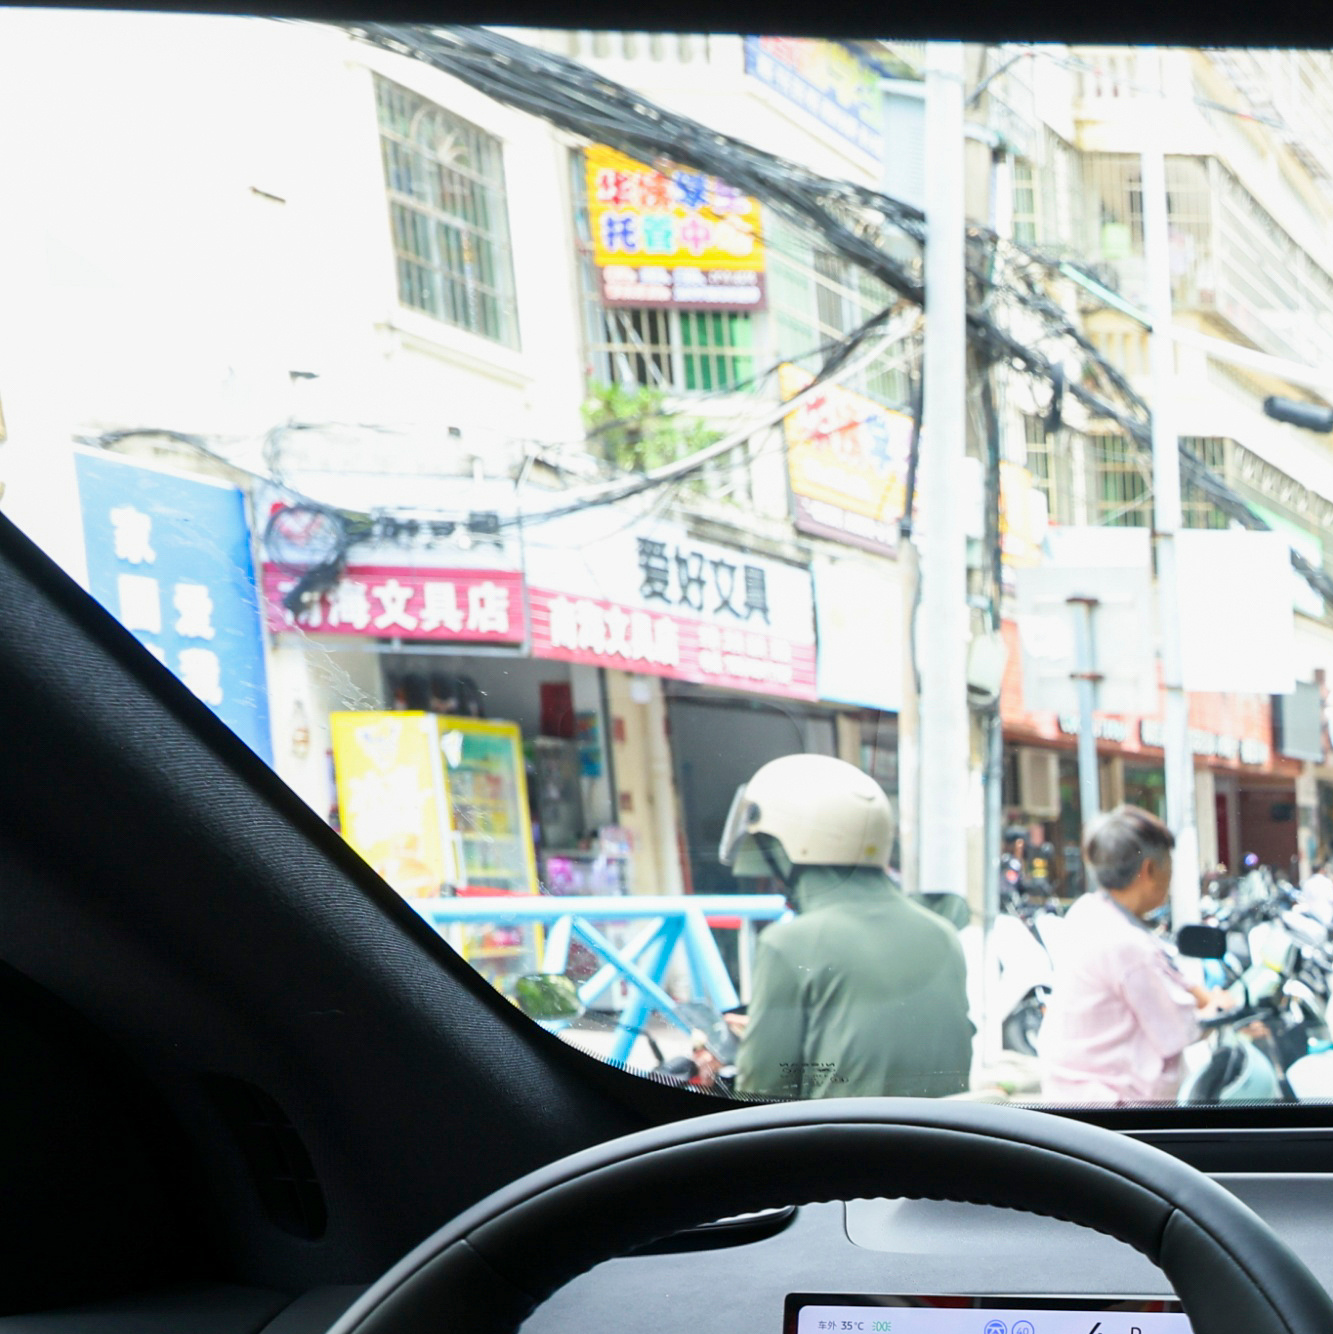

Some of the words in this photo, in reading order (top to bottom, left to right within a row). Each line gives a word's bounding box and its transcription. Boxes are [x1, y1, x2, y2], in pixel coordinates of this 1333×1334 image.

[636, 536, 771, 626] 爱好文具
[818, 1321, 837, 1330] 车外
